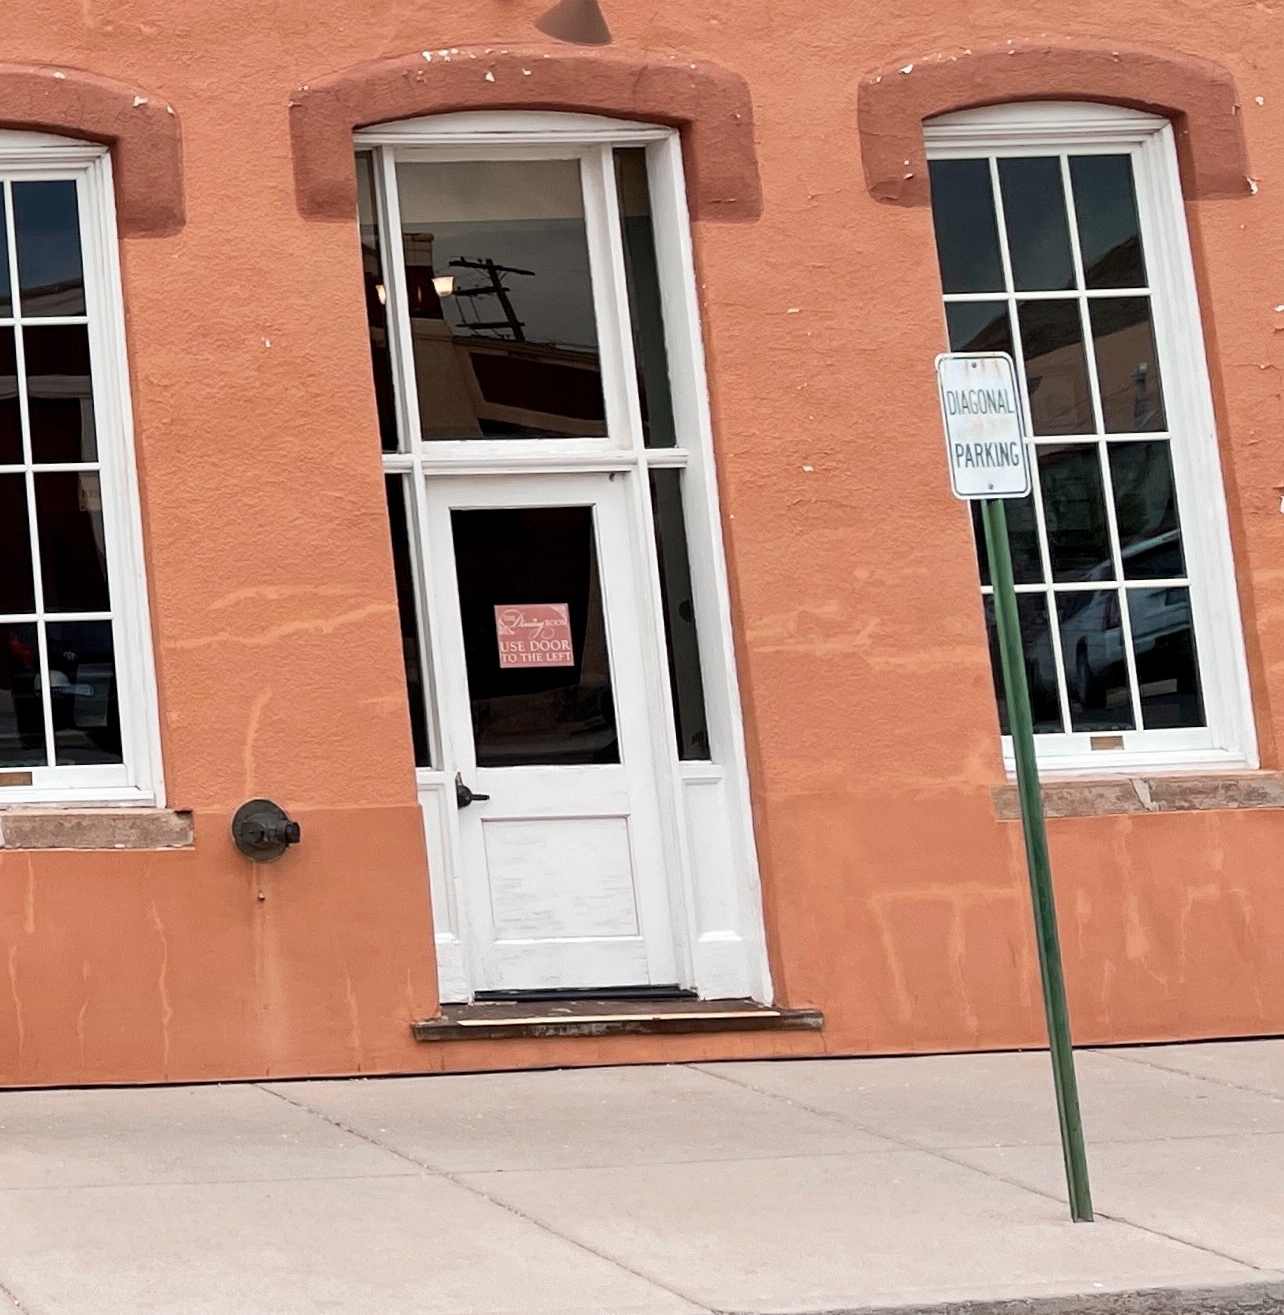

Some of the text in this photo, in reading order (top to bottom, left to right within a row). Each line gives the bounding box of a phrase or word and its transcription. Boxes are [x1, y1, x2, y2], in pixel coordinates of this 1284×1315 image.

[946, 388, 1015, 416] DIAGONAL
[955, 442, 1019, 468] PARKING
[500, 640, 570, 652] USE DOOR
[501, 652, 571, 663] TO THE LEFT
